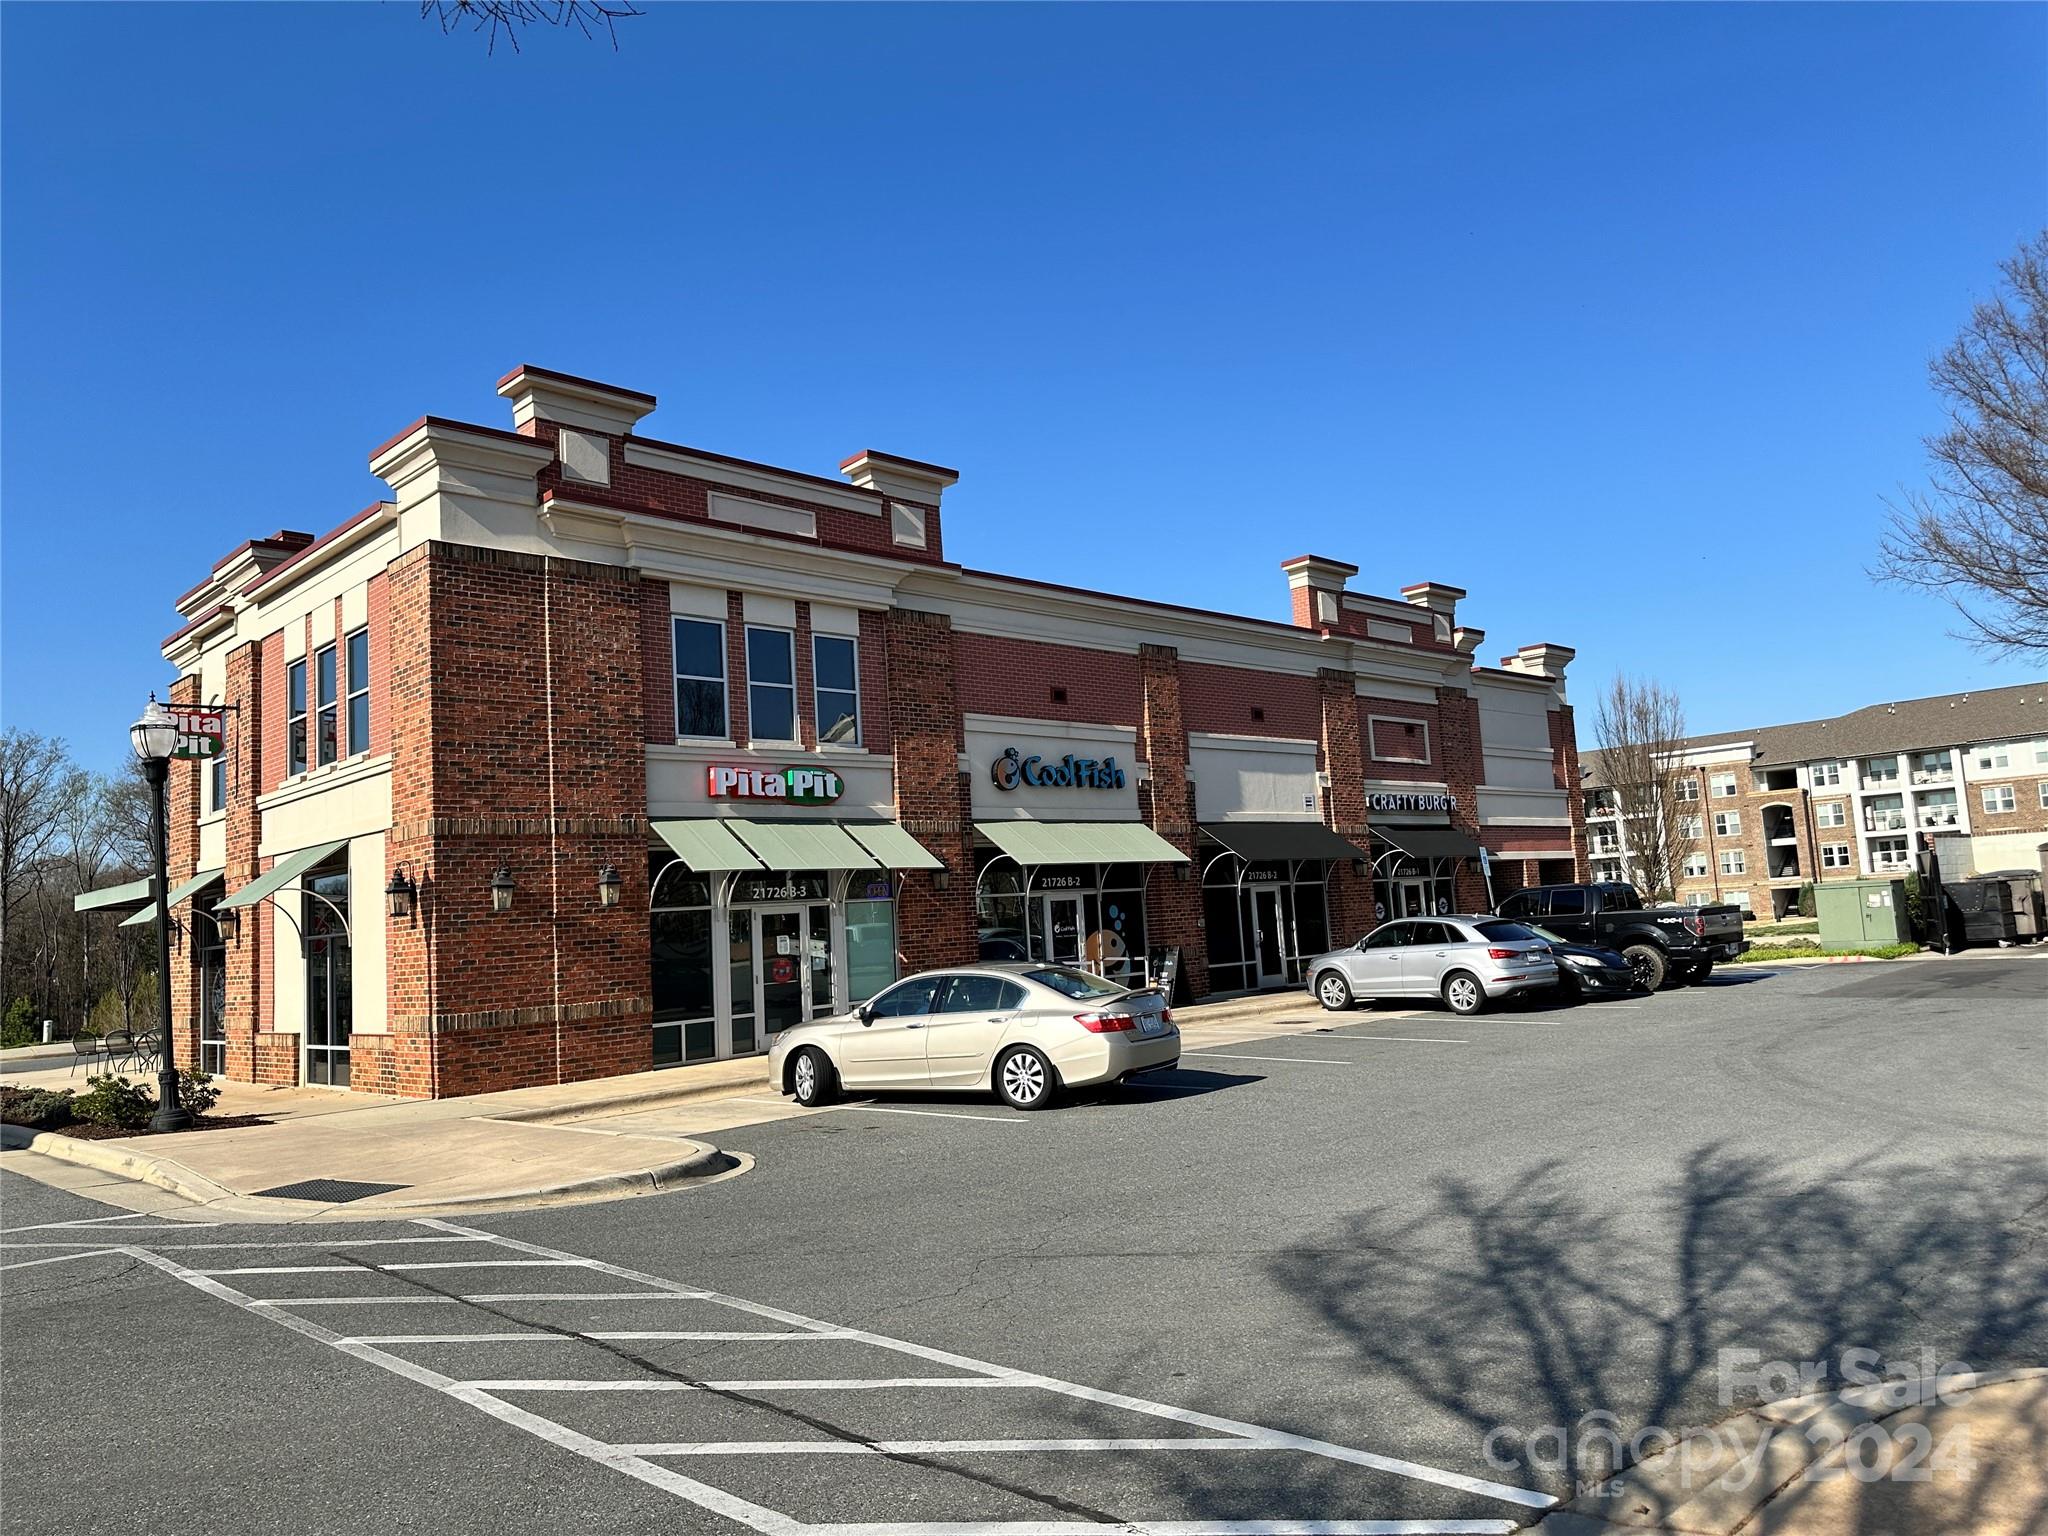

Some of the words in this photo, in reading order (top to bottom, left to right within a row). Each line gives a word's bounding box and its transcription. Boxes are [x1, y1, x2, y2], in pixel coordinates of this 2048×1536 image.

[172, 734, 212, 754] Pit
[1021, 754, 1126, 789] CoolFish
[710, 767, 787, 797] Pita
[788, 770, 838, 797] Pit
[1373, 794, 1415, 810] CRAFTY
[1418, 795, 1457, 810] BURG'R
[1042, 877, 1067, 888] 21726
[1067, 876, 1081, 887] B-2
[1248, 871, 1267, 880] 21726
[752, 886, 787, 899] 21726
[789, 885, 807, 898] B-3
